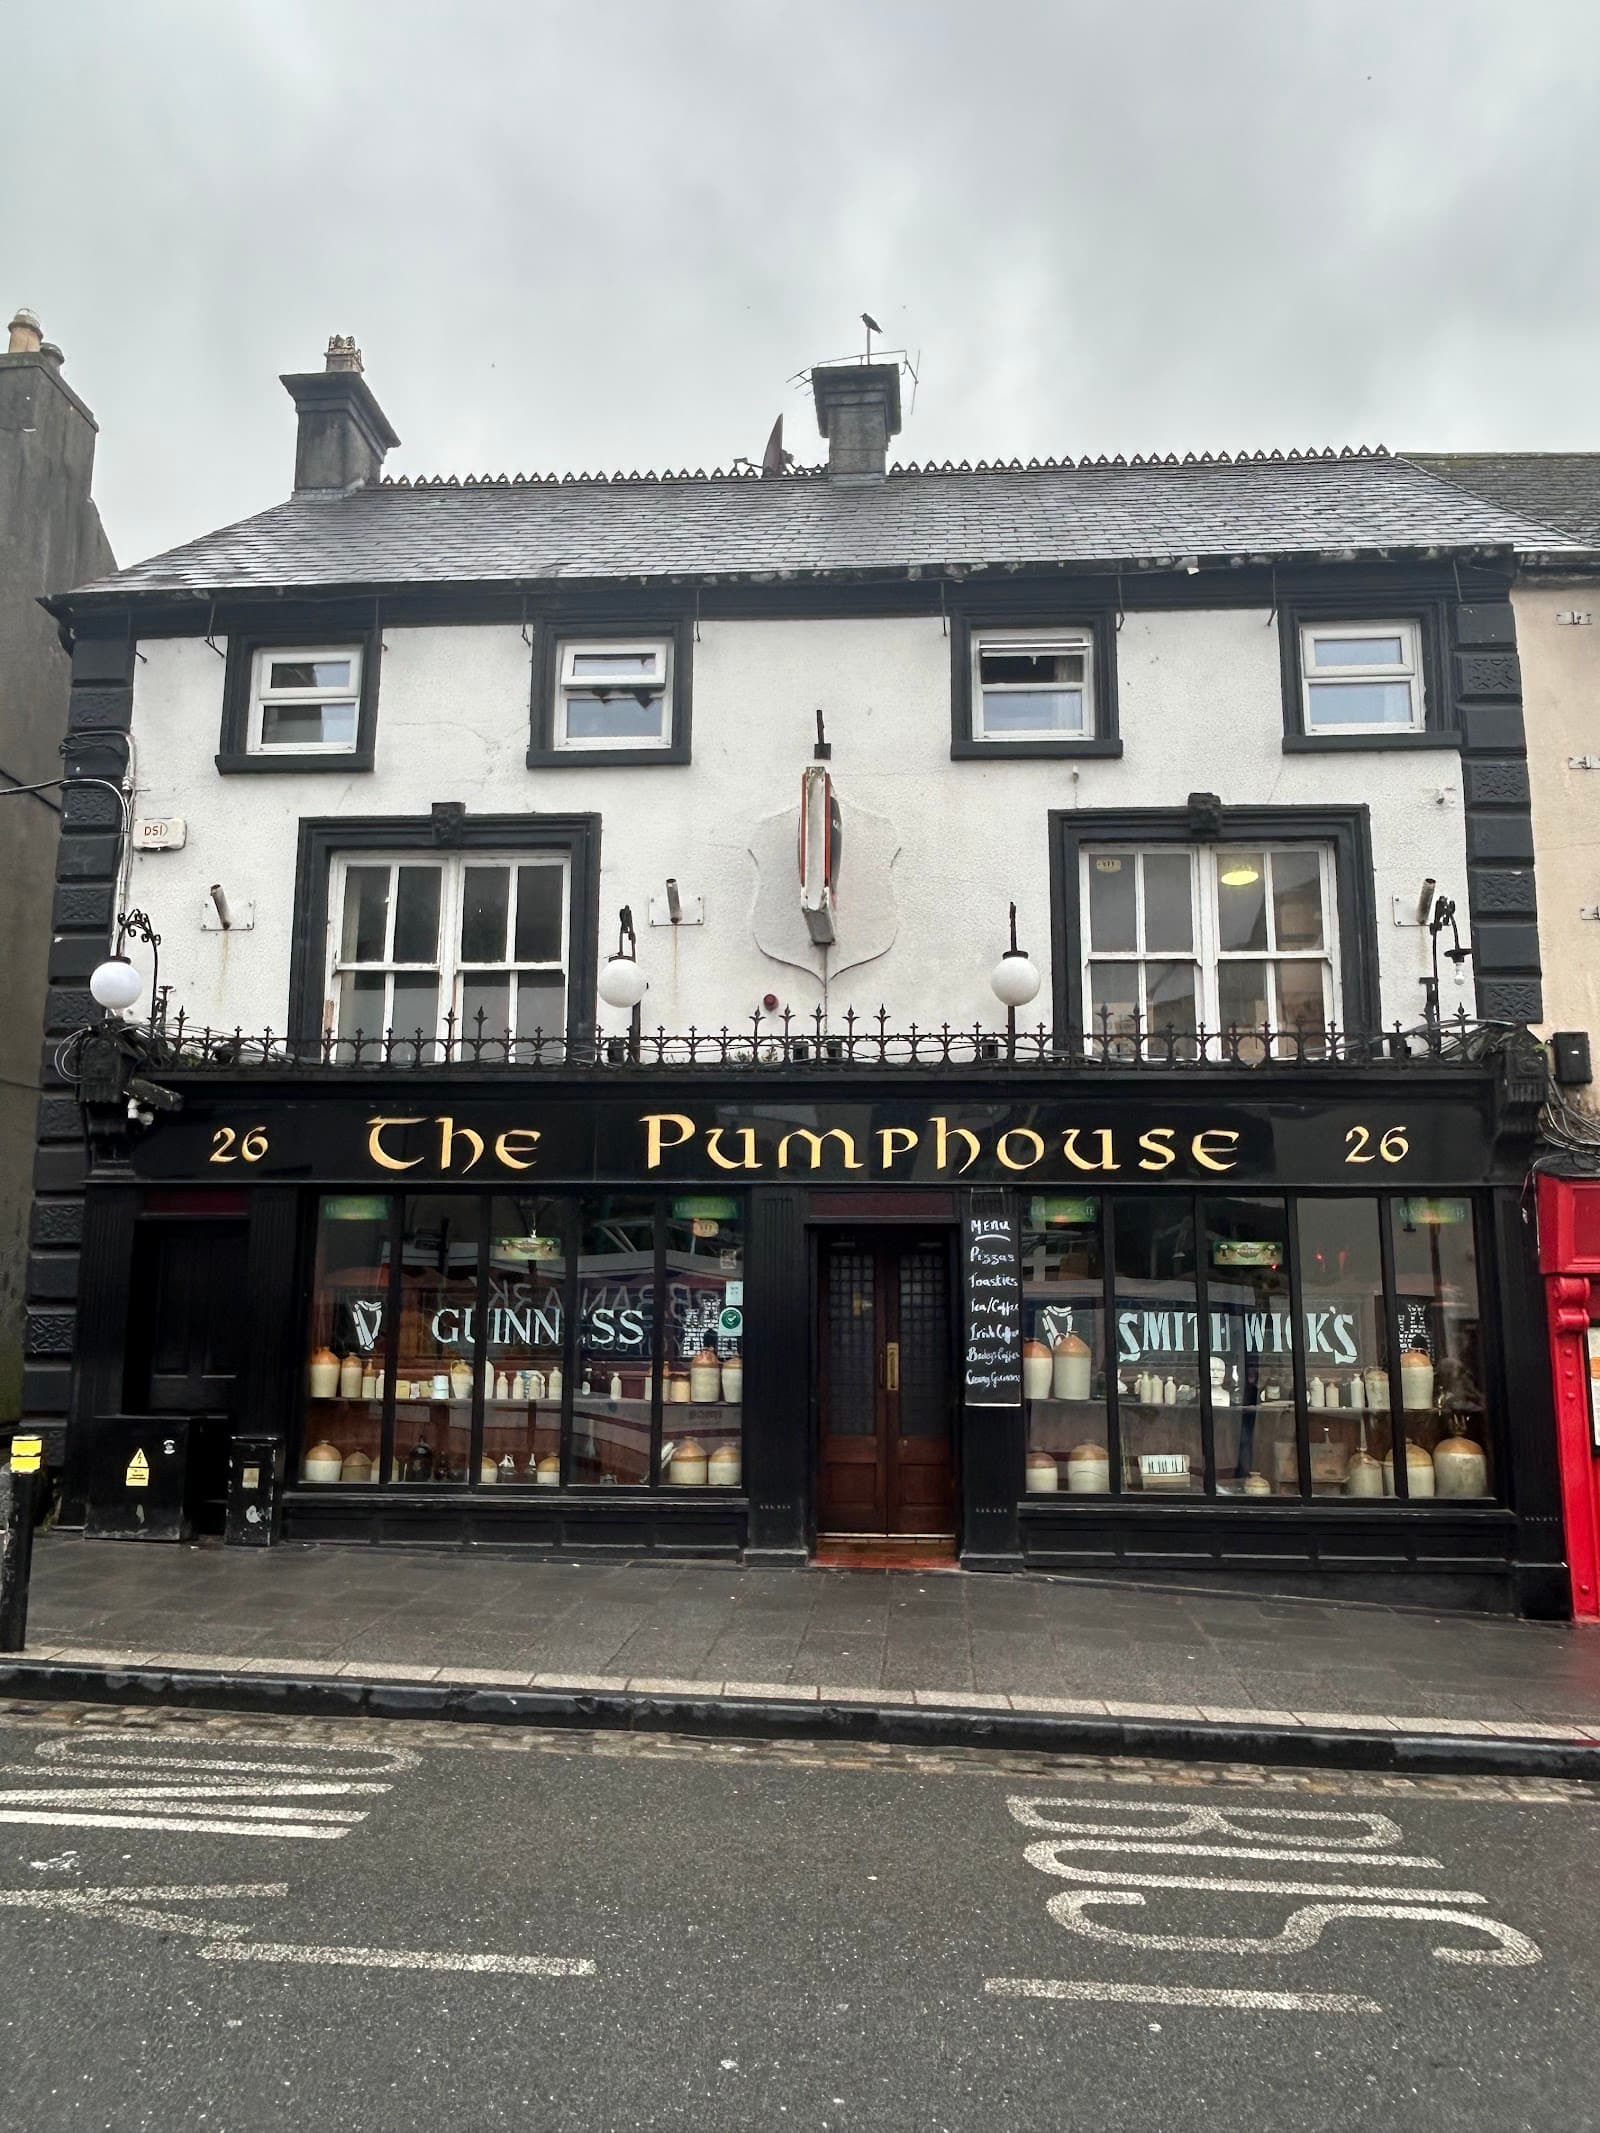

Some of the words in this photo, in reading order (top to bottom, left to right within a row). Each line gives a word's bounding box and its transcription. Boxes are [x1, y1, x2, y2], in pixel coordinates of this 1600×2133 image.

[209, 1126, 269, 1163] 26
[366, 1115, 541, 1174] The
[639, 1113, 1240, 1174] Pumphouse
[1344, 1125, 1409, 1164] 26
[970, 1246, 1015, 1265] Pizzas
[968, 1271, 1018, 1288] Toasties
[431, 1308, 644, 1345] GUINNSS
[1005, 1795, 1543, 1968] BUS
